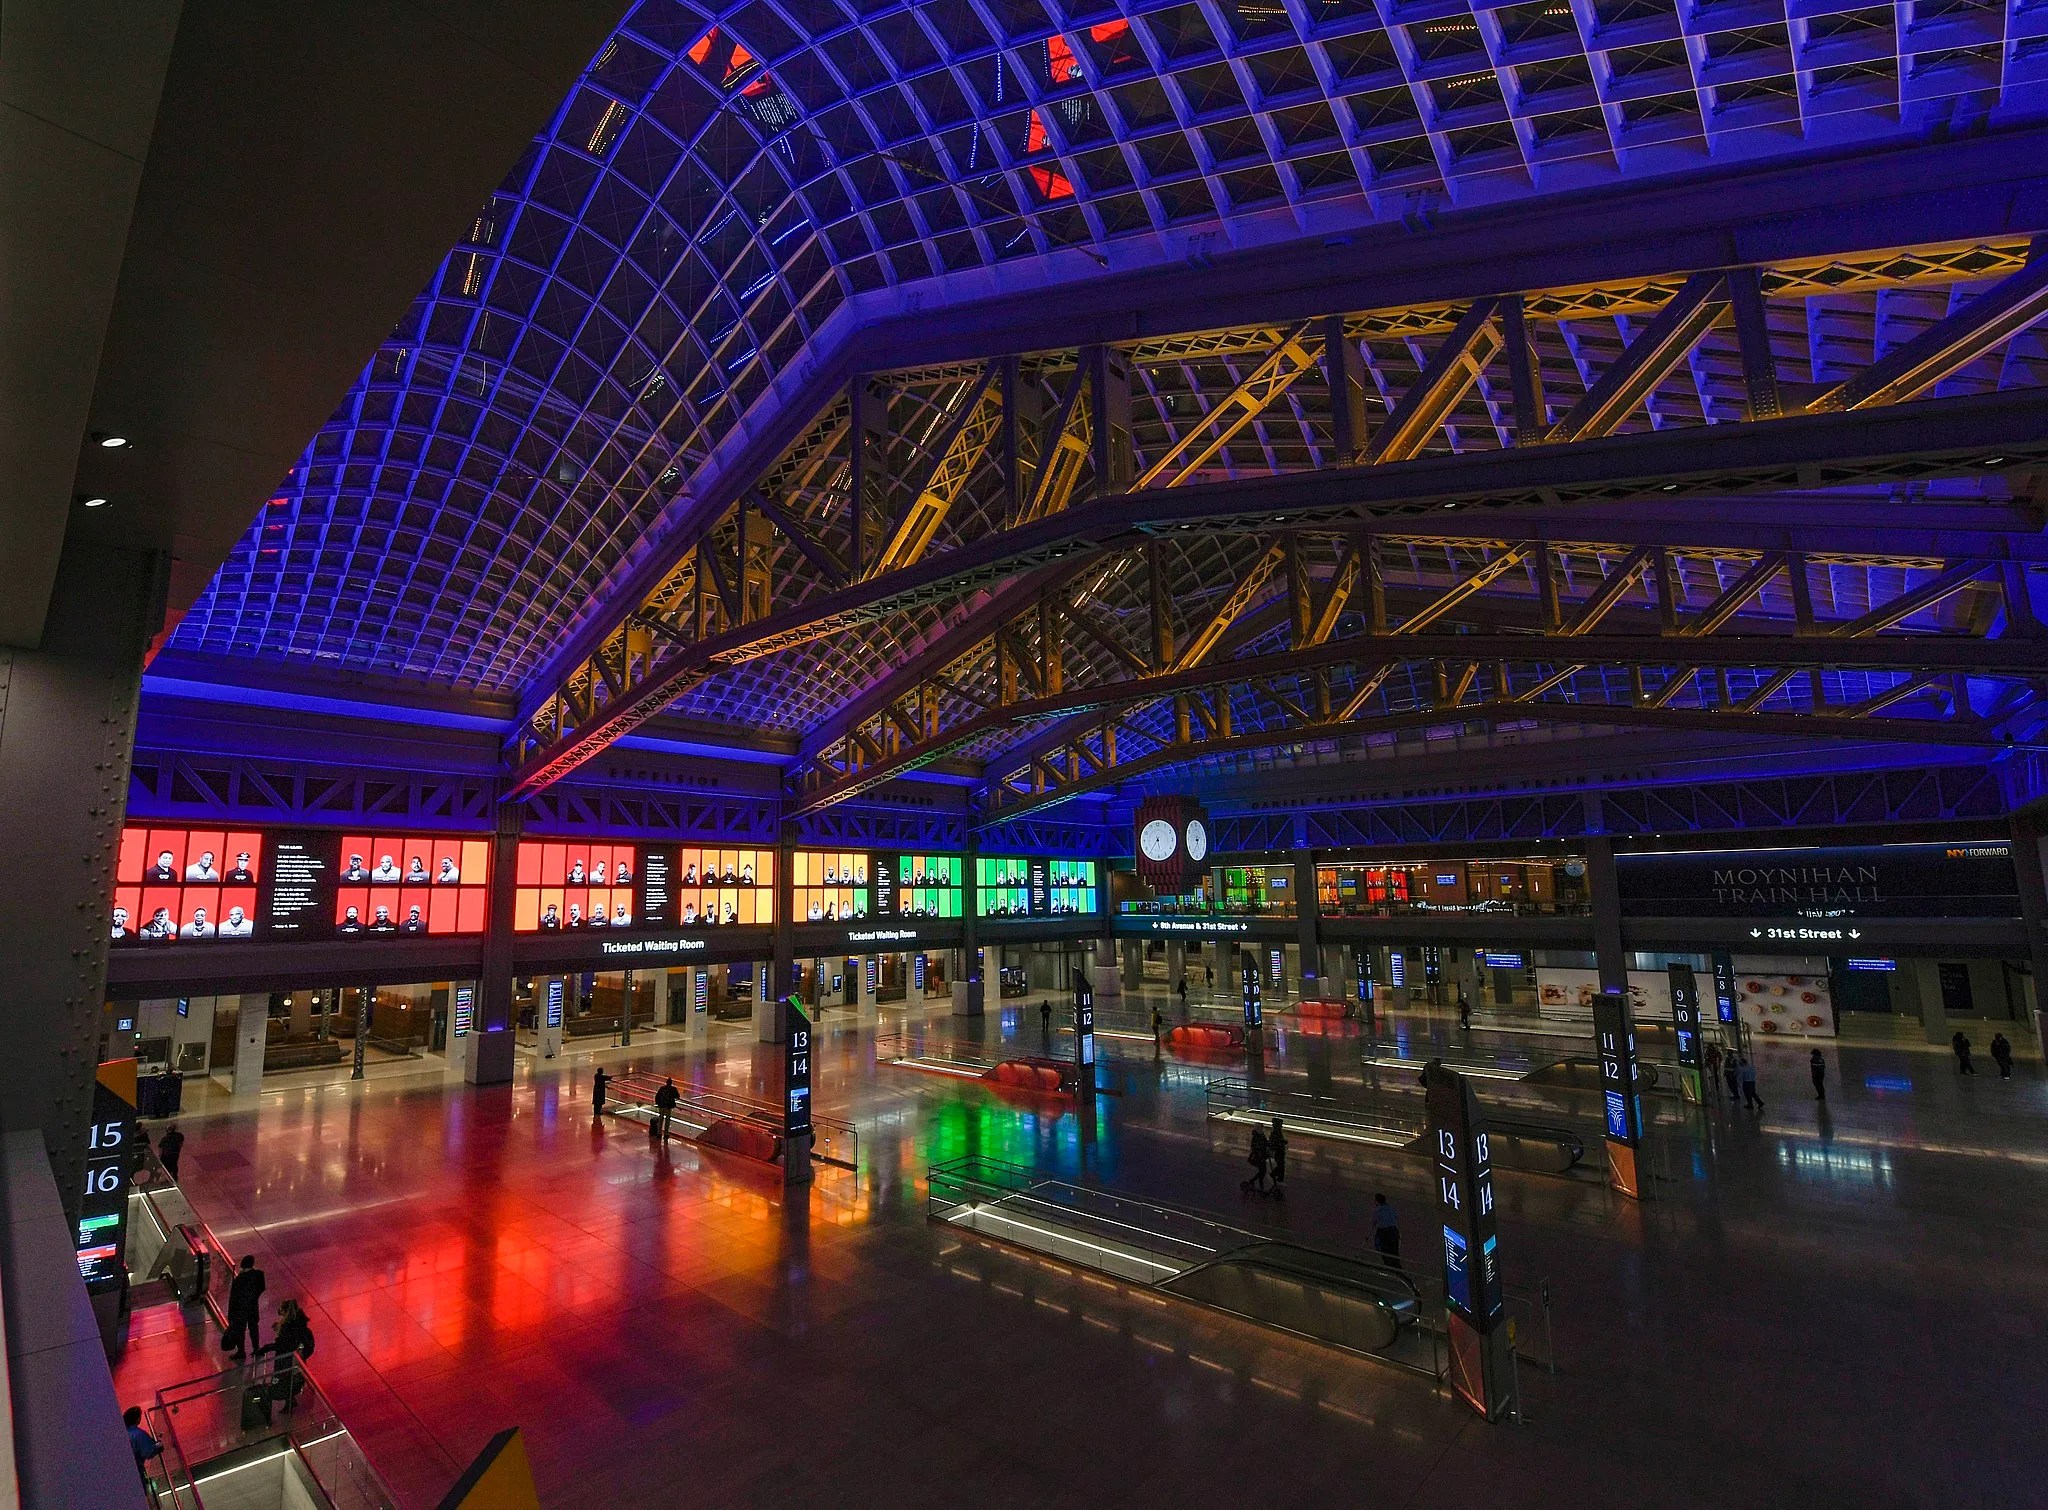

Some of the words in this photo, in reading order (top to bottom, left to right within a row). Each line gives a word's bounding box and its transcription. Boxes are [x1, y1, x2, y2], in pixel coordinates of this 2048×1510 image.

[1945, 848, 1966, 858] NY
[1969, 847, 2009, 857] FORWARD
[1713, 866, 1878, 885] MOYNIHAN
[1712, 887, 1798, 904] TRAIN
[1810, 886, 1886, 903] HALL
[848, 931, 876, 941] Ticketed
[876, 930, 899, 940] Waiting
[899, 929, 917, 939] Room
[1171, 922, 1195, 930] Avenue
[1195, 922, 1202, 930] &
[1202, 922, 1217, 930] 31st
[1217, 923, 1239, 931] Street
[1767, 928, 1797, 939] 31st
[1798, 928, 1843, 939] Street
[602, 941, 643, 953] Ticketed
[644, 941, 679, 952] Waiting
[679, 939, 705, 950] Room
[1717, 965, 1723, 975] 7
[1719, 980, 1725, 990] 8
[1083, 993, 1090, 1005] 11
[1676, 989, 1684, 1002] 9
[1083, 1013, 1092, 1025] 12
[1677, 1010, 1688, 1022] 10
[793, 1031, 808, 1048] 13
[1602, 1032, 1614, 1050] 11
[792, 1058, 808, 1076] 14
[1604, 1060, 1619, 1080] 12
[88, 1121, 123, 1150] 15
[1438, 1128, 1455, 1160] 13
[1476, 1133, 1488, 1165] 13
[83, 1166, 120, 1196] 16
[1441, 1176, 1460, 1211] 14
[1480, 1182, 1492, 1216] 14
